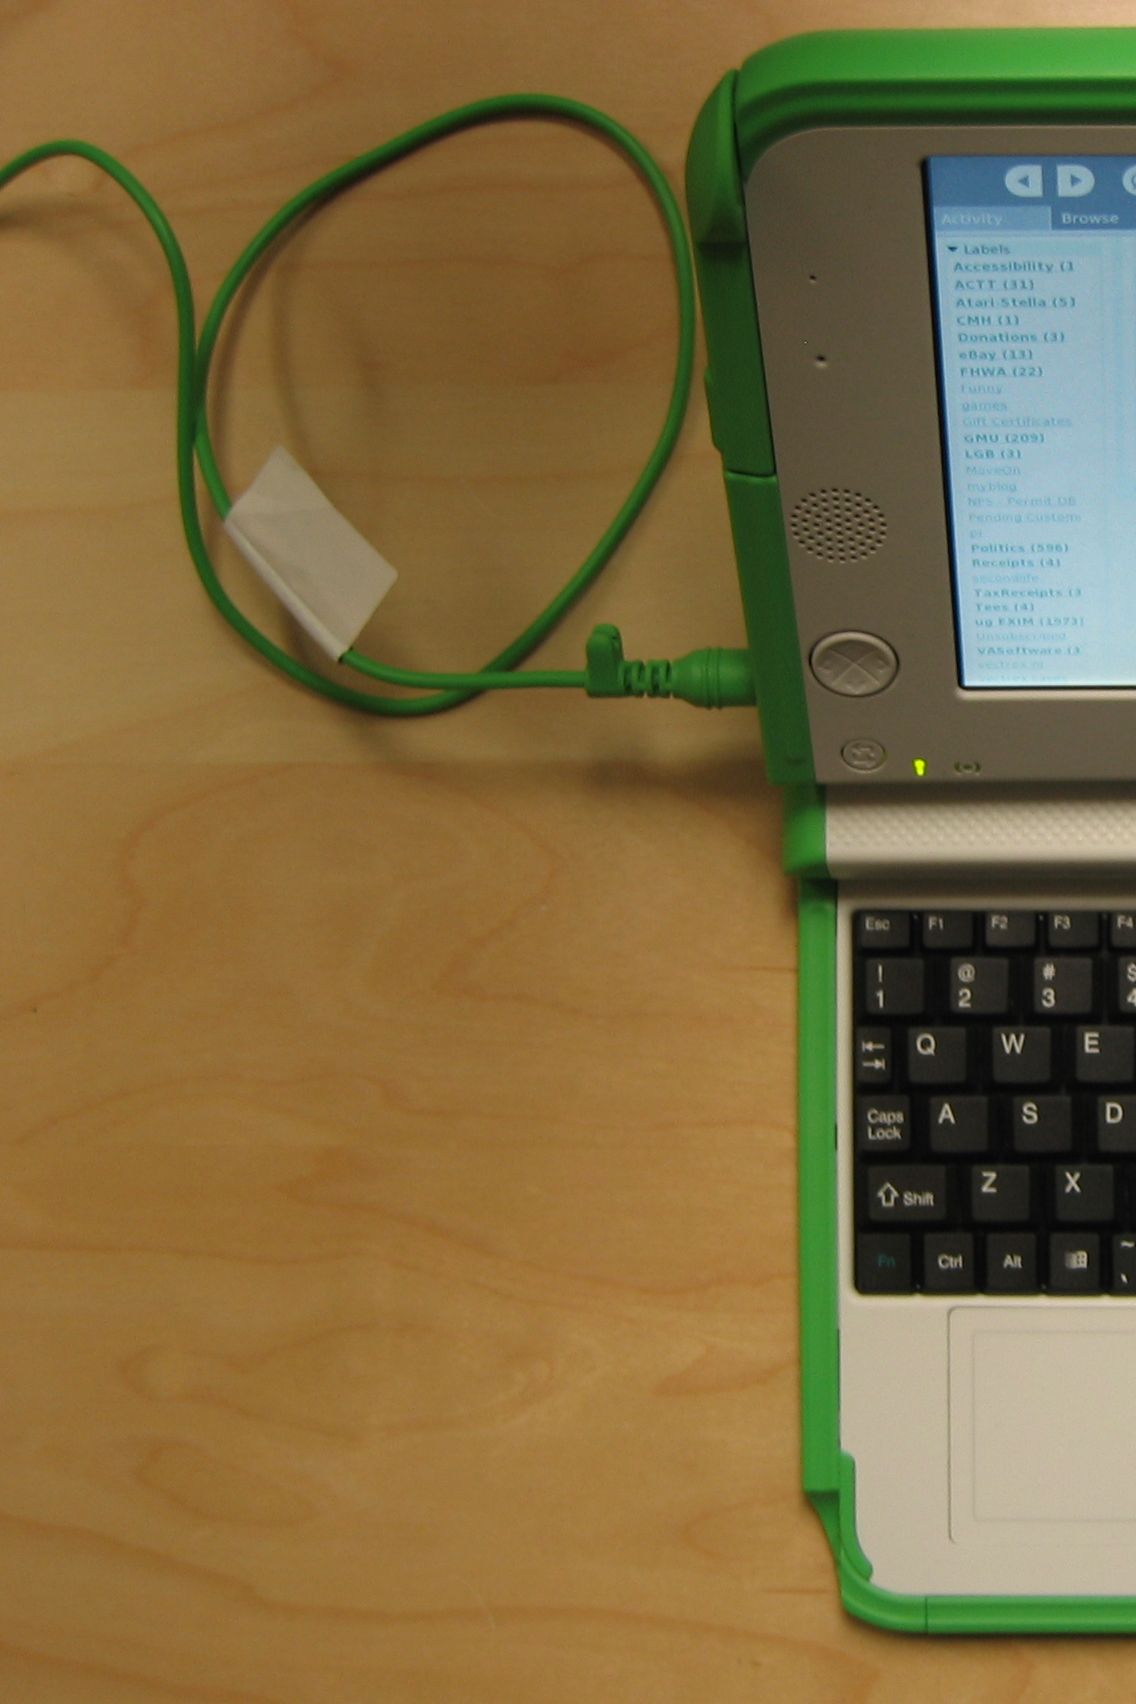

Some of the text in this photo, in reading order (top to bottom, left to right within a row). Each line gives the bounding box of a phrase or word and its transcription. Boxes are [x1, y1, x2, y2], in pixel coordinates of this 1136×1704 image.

[942, 213, 1003, 226] Activity
[1062, 213, 1119, 225] Browse
[964, 244, 1011, 255] Labels
[953, 261, 1053, 273] Accessibility
[955, 280, 996, 290] ACTT
[956, 298, 994, 308] Atari
[1001, 298, 1046, 308] Stella
[957, 332, 1037, 342] Donations
[959, 350, 996, 361] eBay
[960, 366, 1006, 376] FHWA
[963, 433, 999, 443] GMU
[971, 543, 1025, 553] Politics
[972, 558, 1034, 569] Receipts
[974, 588, 1062, 598] TaxReceipts
[865, 917, 891, 930] Esc
[928, 917, 944, 930] F1
[991, 916, 1009, 929] F2
[1054, 916, 1071, 930] F3
[1117, 915, 1135, 928] F4
[876, 989, 885, 1008] 1
[958, 988, 973, 1008] 2
[1042, 988, 1056, 1008] 3
[916, 1033, 937, 1056] Q
[1001, 1032, 1025, 1055] W
[1084, 1032, 1101, 1054] E
[867, 1109, 904, 1126] Caps
[938, 1103, 956, 1124] A
[1021, 1102, 1039, 1125] S
[1105, 1102, 1124, 1124] D
[867, 1126, 903, 1141] Lock
[981, 1171, 998, 1193] Z
[1064, 1171, 1082, 1193] X
[903, 1191, 935, 1208] Shift
[876, 1253, 896, 1268] Fn
[938, 1253, 964, 1269] Ctrl
[1003, 1253, 1023, 1269] Alt
